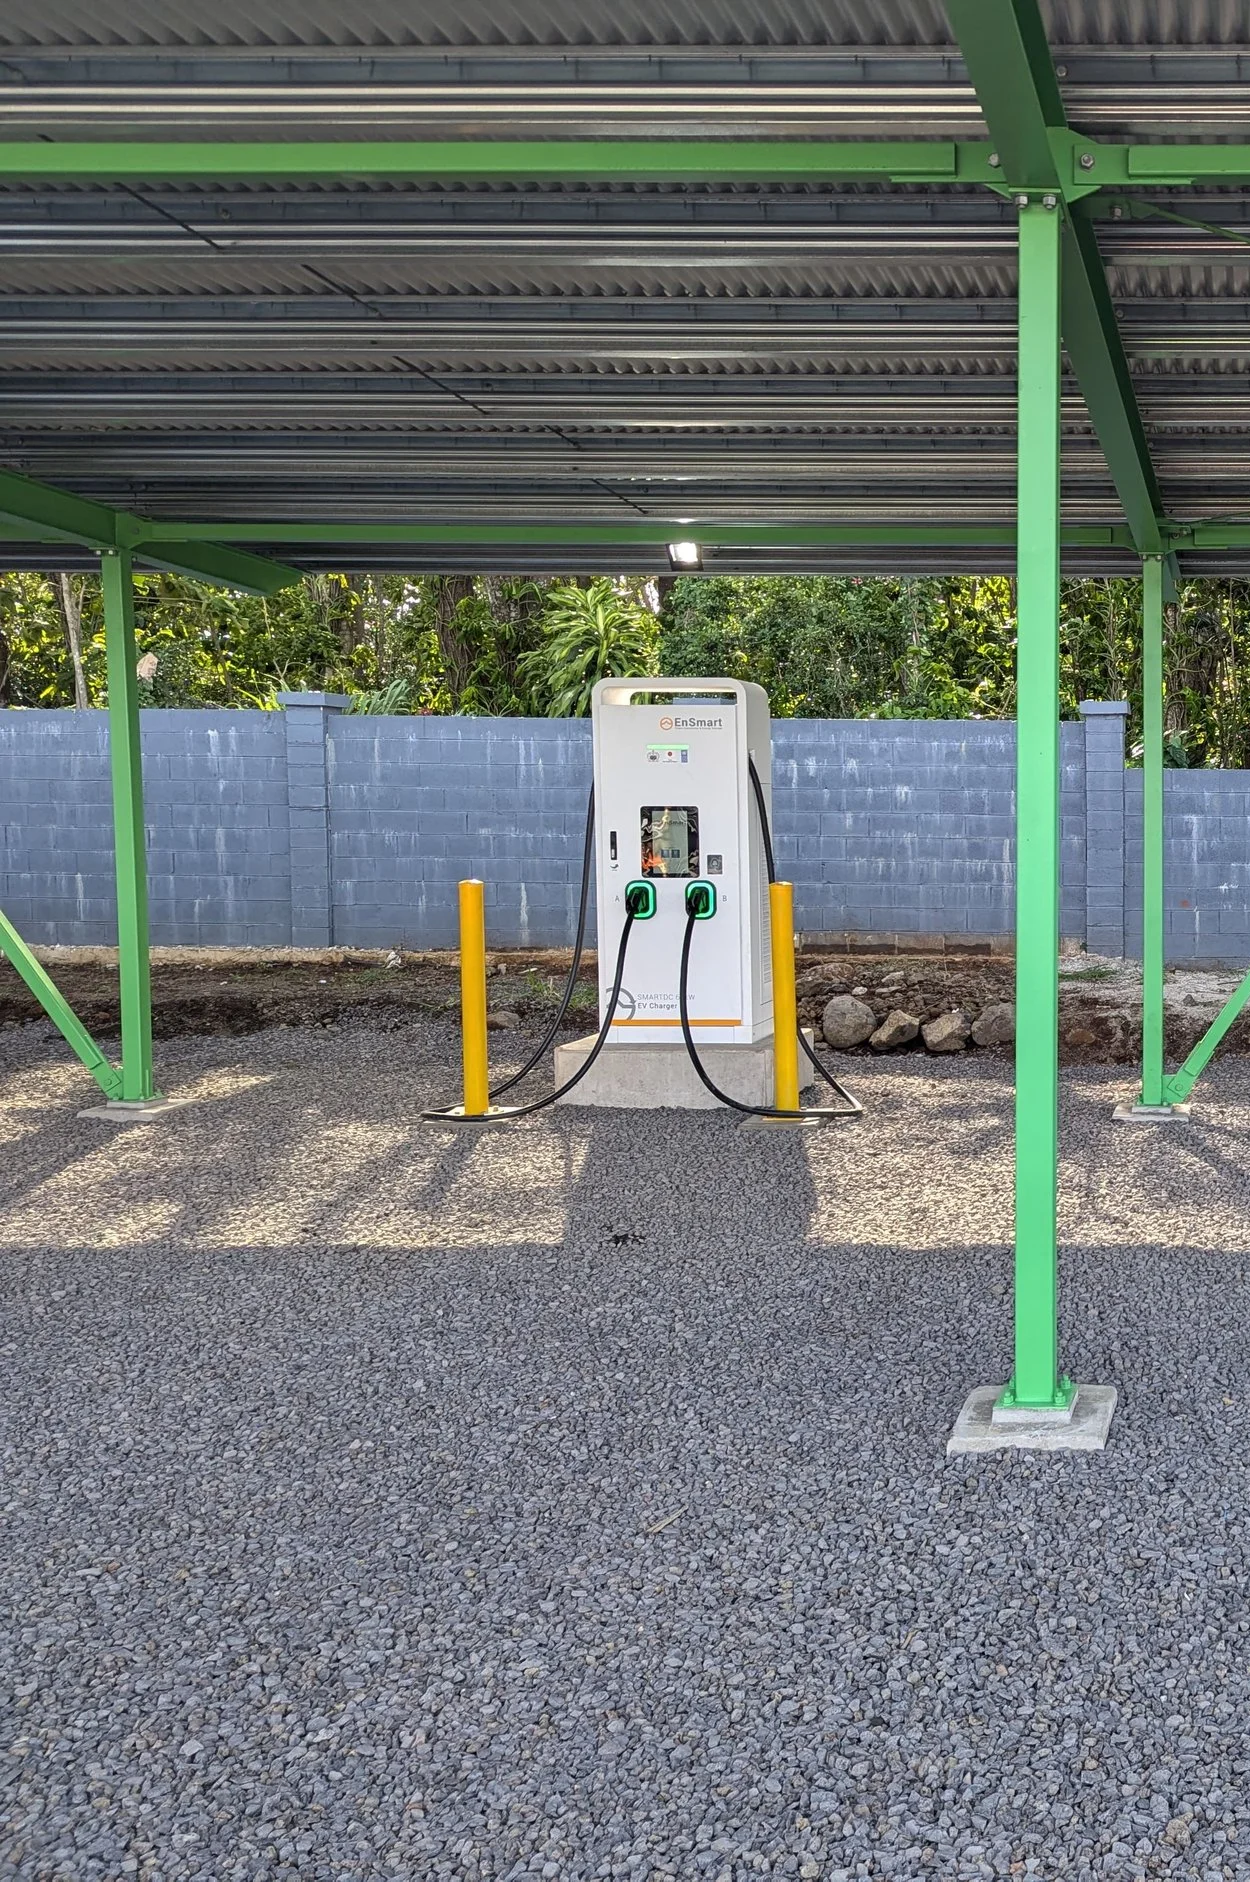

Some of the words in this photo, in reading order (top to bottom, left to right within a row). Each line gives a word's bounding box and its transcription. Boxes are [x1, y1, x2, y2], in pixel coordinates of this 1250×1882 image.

[674, 717, 722, 727] EnSmart
[722, 894, 728, 902] B
[637, 993, 674, 1001] SMARTDC
[649, 1002, 678, 1011] Charger
